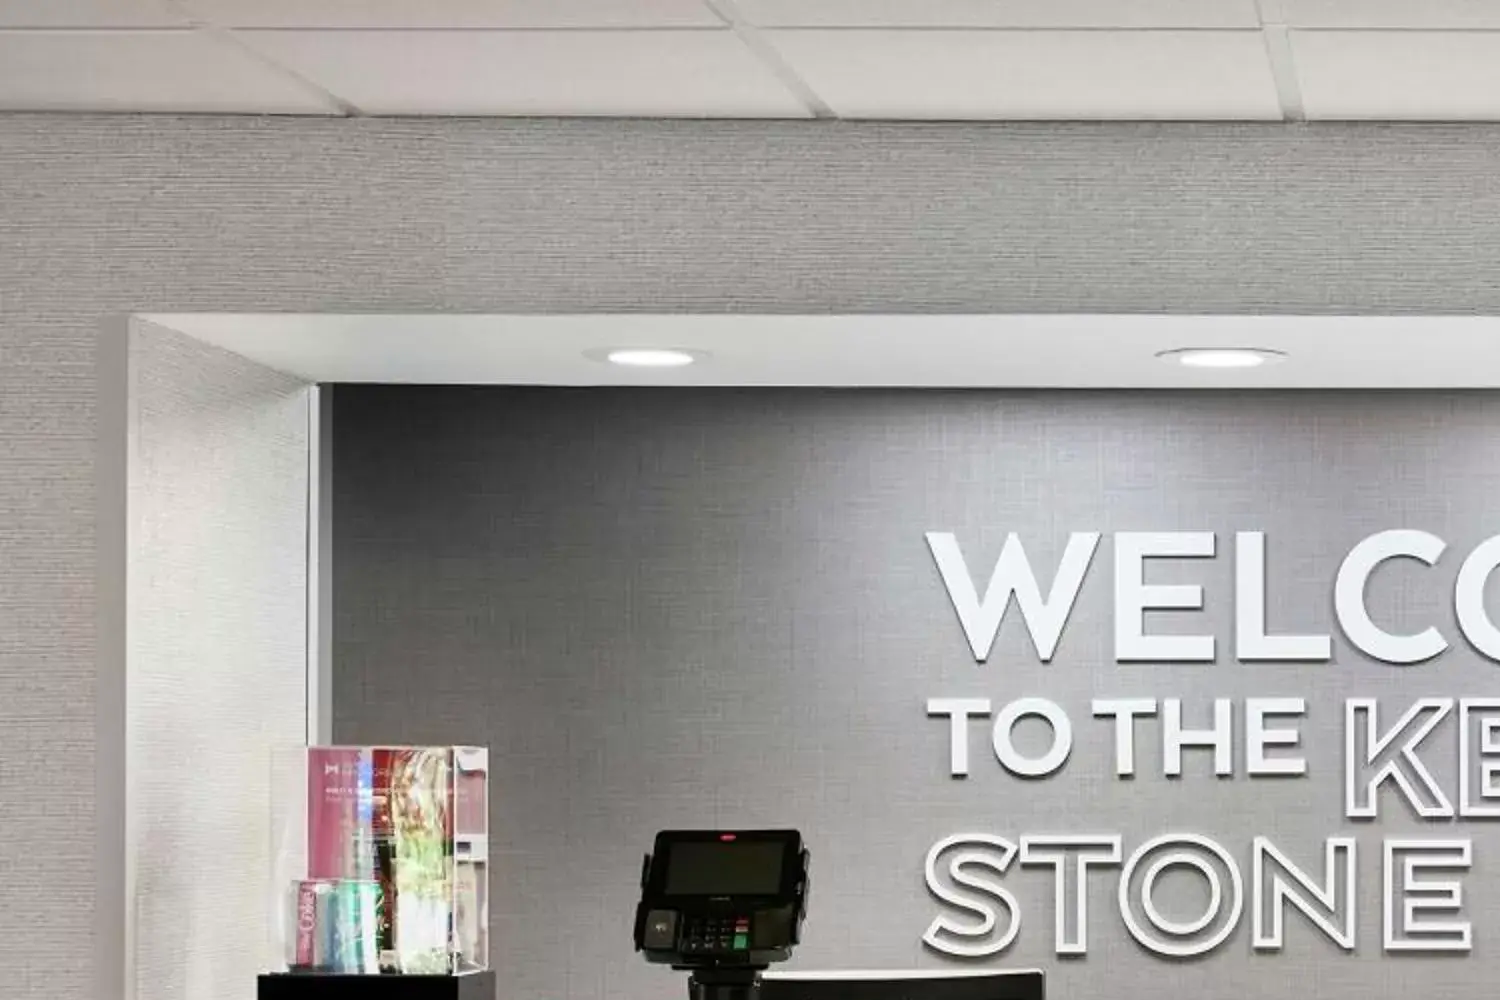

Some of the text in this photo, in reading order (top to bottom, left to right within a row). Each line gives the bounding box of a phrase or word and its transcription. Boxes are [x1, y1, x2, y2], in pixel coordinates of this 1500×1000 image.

[927, 697, 1072, 777] TO
[1091, 697, 1307, 777] THE
[922, 833, 1473, 957] STONE
